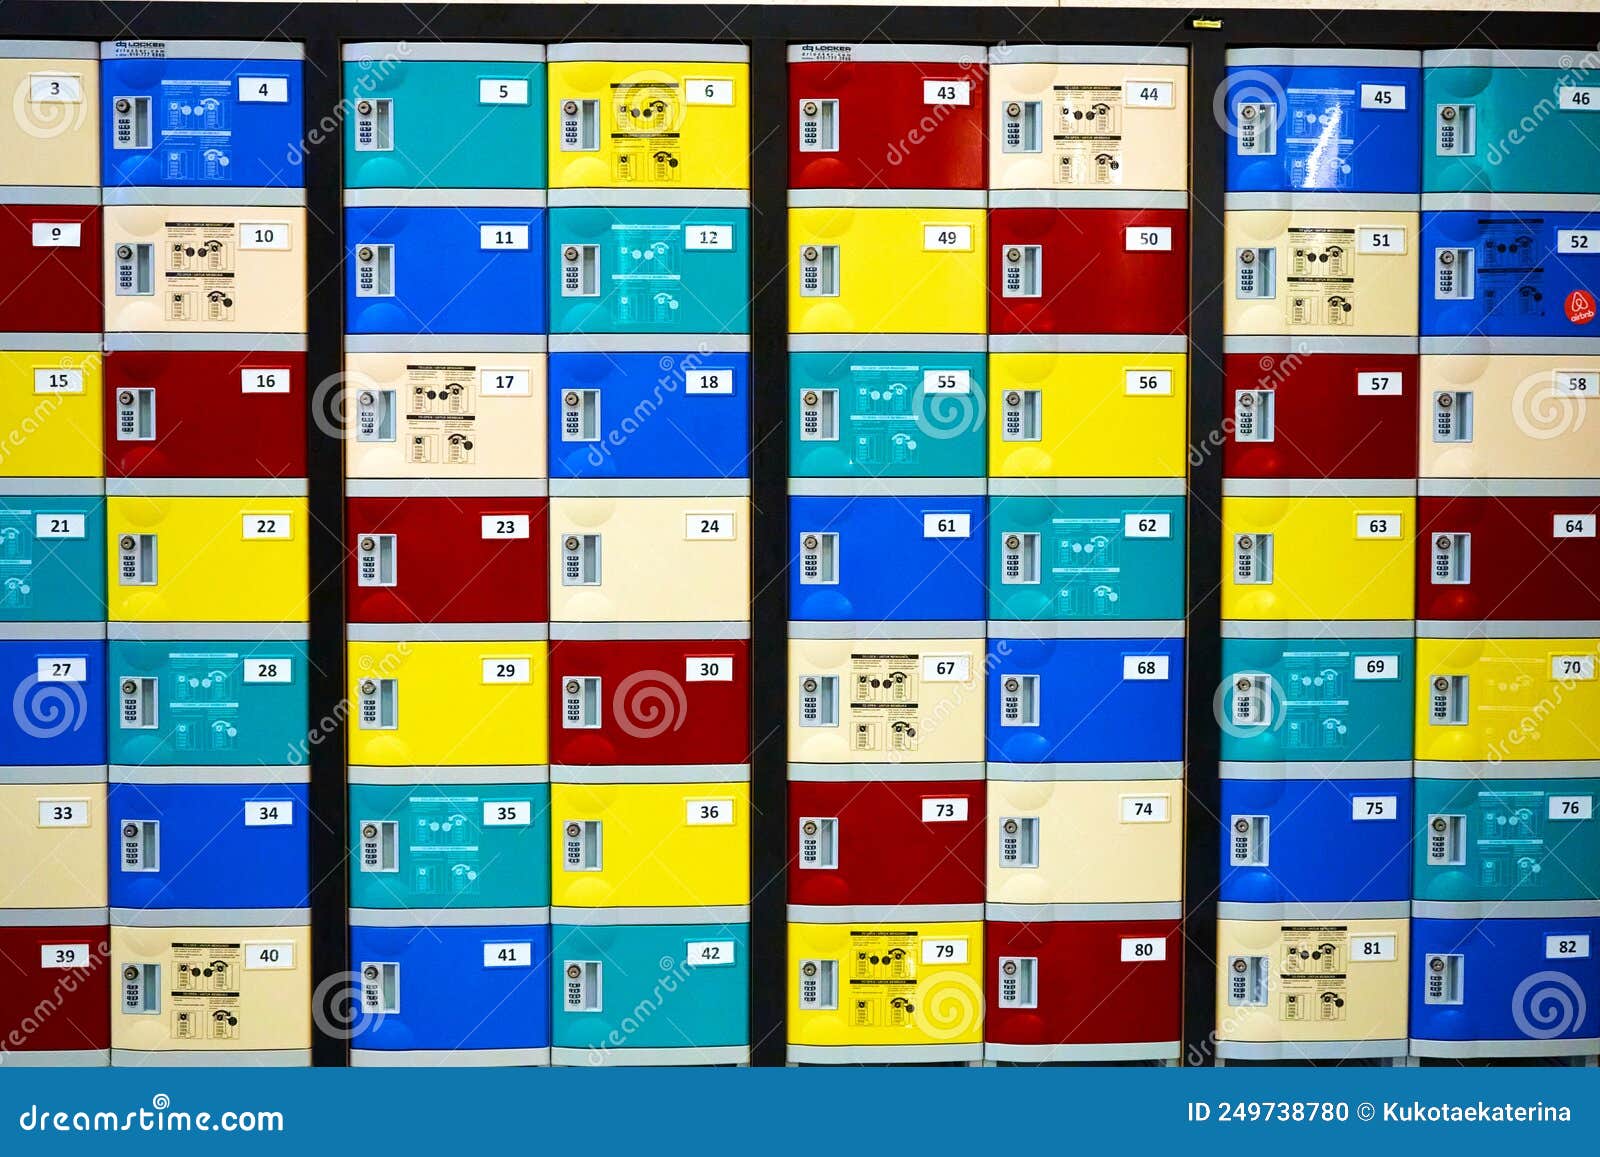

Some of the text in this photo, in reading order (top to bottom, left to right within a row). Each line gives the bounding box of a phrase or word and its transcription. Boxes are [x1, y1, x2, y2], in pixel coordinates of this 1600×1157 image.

[50, 81, 60, 95] 3
[258, 83, 269, 97] 4
[499, 85, 508, 99] 5
[704, 84, 714, 98] 6
[937, 86, 956, 100] 43
[1140, 87, 1159, 101] 44
[1374, 90, 1392, 105] 45
[1571, 91, 1591, 106] 46
[51, 227, 62, 241] 9
[255, 229, 274, 243] 10
[495, 231, 514, 244] 11
[700, 231, 718, 244] 12
[938, 231, 957, 245] 49
[1140, 232, 1158, 246] 50
[1372, 233, 1390, 247] 51
[1570, 235, 1589, 249] 52
[1571, 310, 1594, 322] airbnb
[49, 374, 69, 388] 15
[256, 374, 276, 388] 16
[495, 375, 514, 389] 17
[700, 375, 719, 389] 18
[937, 375, 956, 389] 55
[1139, 375, 1158, 390] 56
[1371, 377, 1389, 391] 57
[1569, 377, 1587, 391] 58
[50, 519, 70, 533] 21
[257, 519, 276, 533] 22
[496, 520, 515, 534] 23
[700, 519, 720, 533] 24
[938, 519, 956, 533] 61
[1138, 519, 1157, 532] 62
[1369, 519, 1387, 533] 63
[1565, 519, 1584, 533] 64
[52, 663, 72, 677] 27
[258, 664, 277, 678] 28
[496, 664, 515, 678] 29
[700, 662, 719, 676] 30
[936, 661, 955, 675] 67
[1137, 661, 1156, 675] 68
[1366, 659, 1385, 673] 69
[1563, 660, 1581, 675] 70
[53, 806, 73, 820] 33
[259, 806, 279, 820] 34
[497, 807, 517, 821] 35
[700, 805, 719, 819] 36
[936, 803, 954, 817] 73
[1134, 802, 1153, 816] 74
[1365, 801, 1384, 815] 75
[1561, 801, 1580, 815] 76
[701, 947, 720, 960] 42
[935, 944, 954, 958] 79
[1134, 943, 1153, 957] 80
[1363, 941, 1381, 955] 81
[1559, 940, 1577, 954] 82
[55, 949, 75, 963] 39
[259, 949, 279, 963] 40
[497, 948, 517, 962] 41
